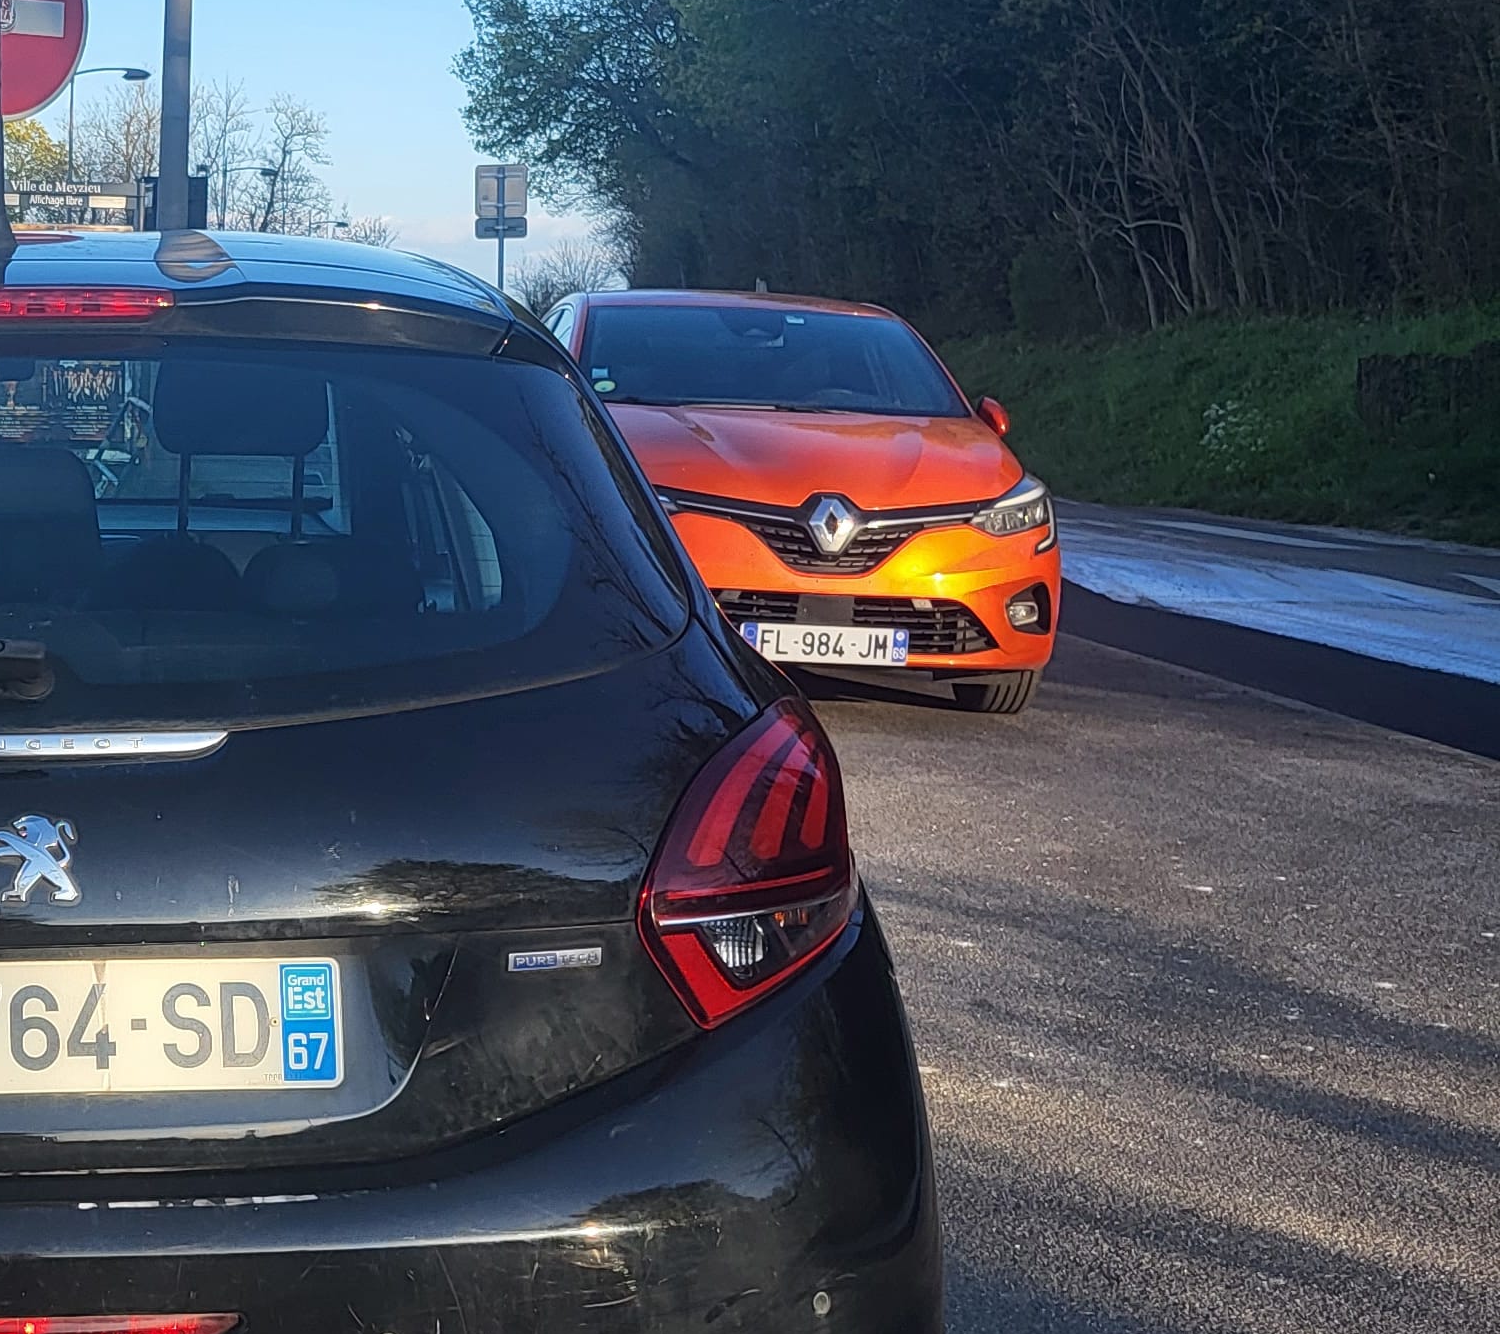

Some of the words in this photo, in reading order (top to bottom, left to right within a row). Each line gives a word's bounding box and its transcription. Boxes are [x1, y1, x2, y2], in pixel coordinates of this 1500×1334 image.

[11, 180, 37, 192] Ville
[38, 180, 53, 193] de
[55, 181, 101, 195] Meyzieu
[29, 195, 65, 207] Affichage
[66, 196, 83, 207] libre
[760, 629, 888, 660] FL-984-JM
[892, 647, 906, 660] 69
[287, 973, 326, 986] Grand
[287, 986, 326, 1010] Est
[287, 1032, 329, 1071] 67
